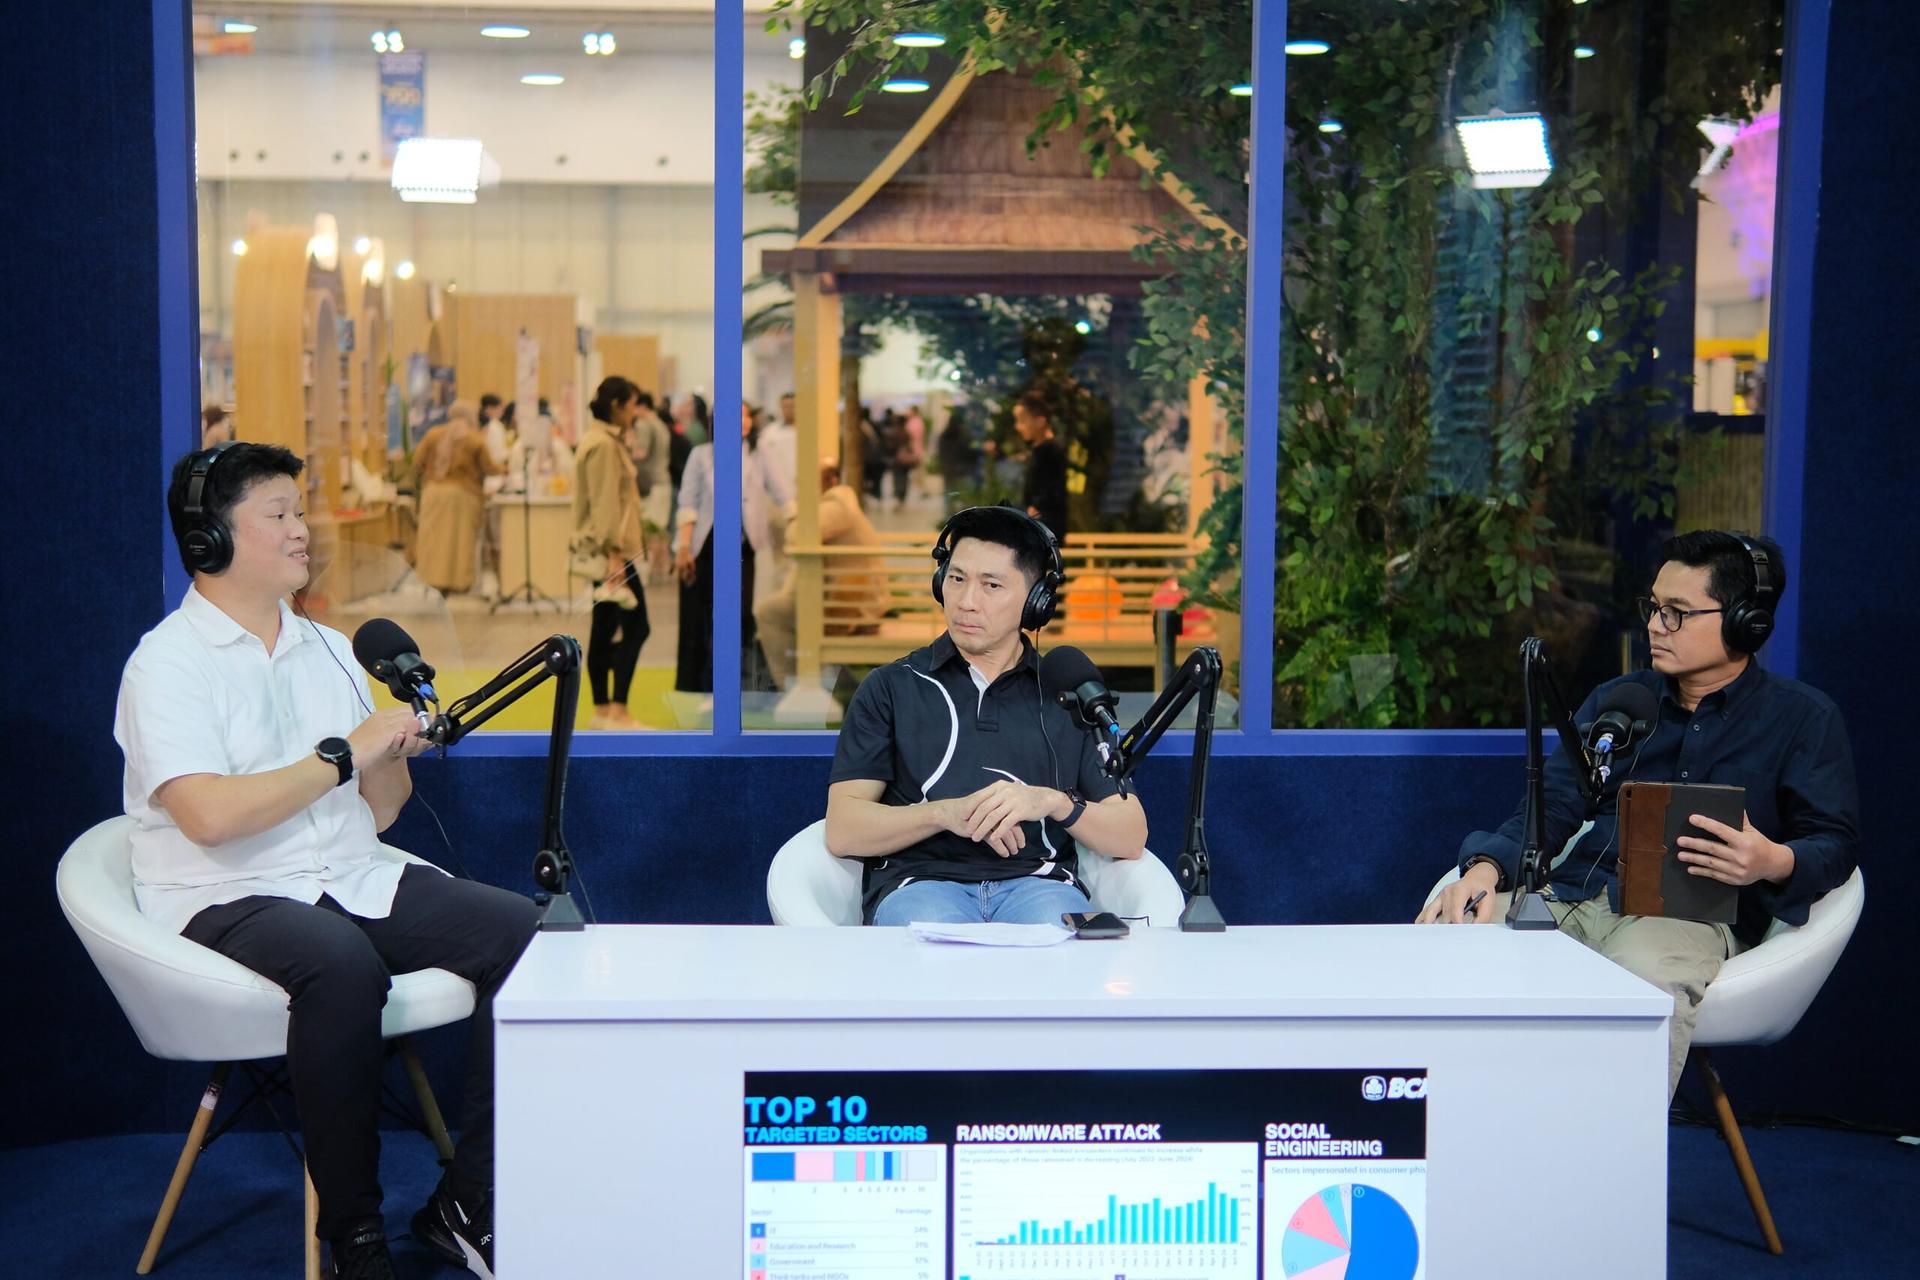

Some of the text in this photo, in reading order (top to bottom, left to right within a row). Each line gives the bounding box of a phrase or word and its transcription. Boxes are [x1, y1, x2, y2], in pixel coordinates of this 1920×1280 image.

[745, 1096, 867, 1124] TOP 10
[745, 1126, 928, 1143] TARGETED SECTORS
[956, 1124, 1161, 1141] RANSOMWARE ATTACK
[1265, 1123, 1331, 1139] SOCIAL
[1265, 1140, 1383, 1156] ENGINEERING
[1271, 1166, 1301, 1175] Sectors
[1302, 1166, 1358, 1176] impersonated
[1359, 1166, 1367, 1174] in
[1368, 1167, 1408, 1175] consumer
[807, 1242, 821, 1250] and
[769, 1258, 815, 1266] Government
